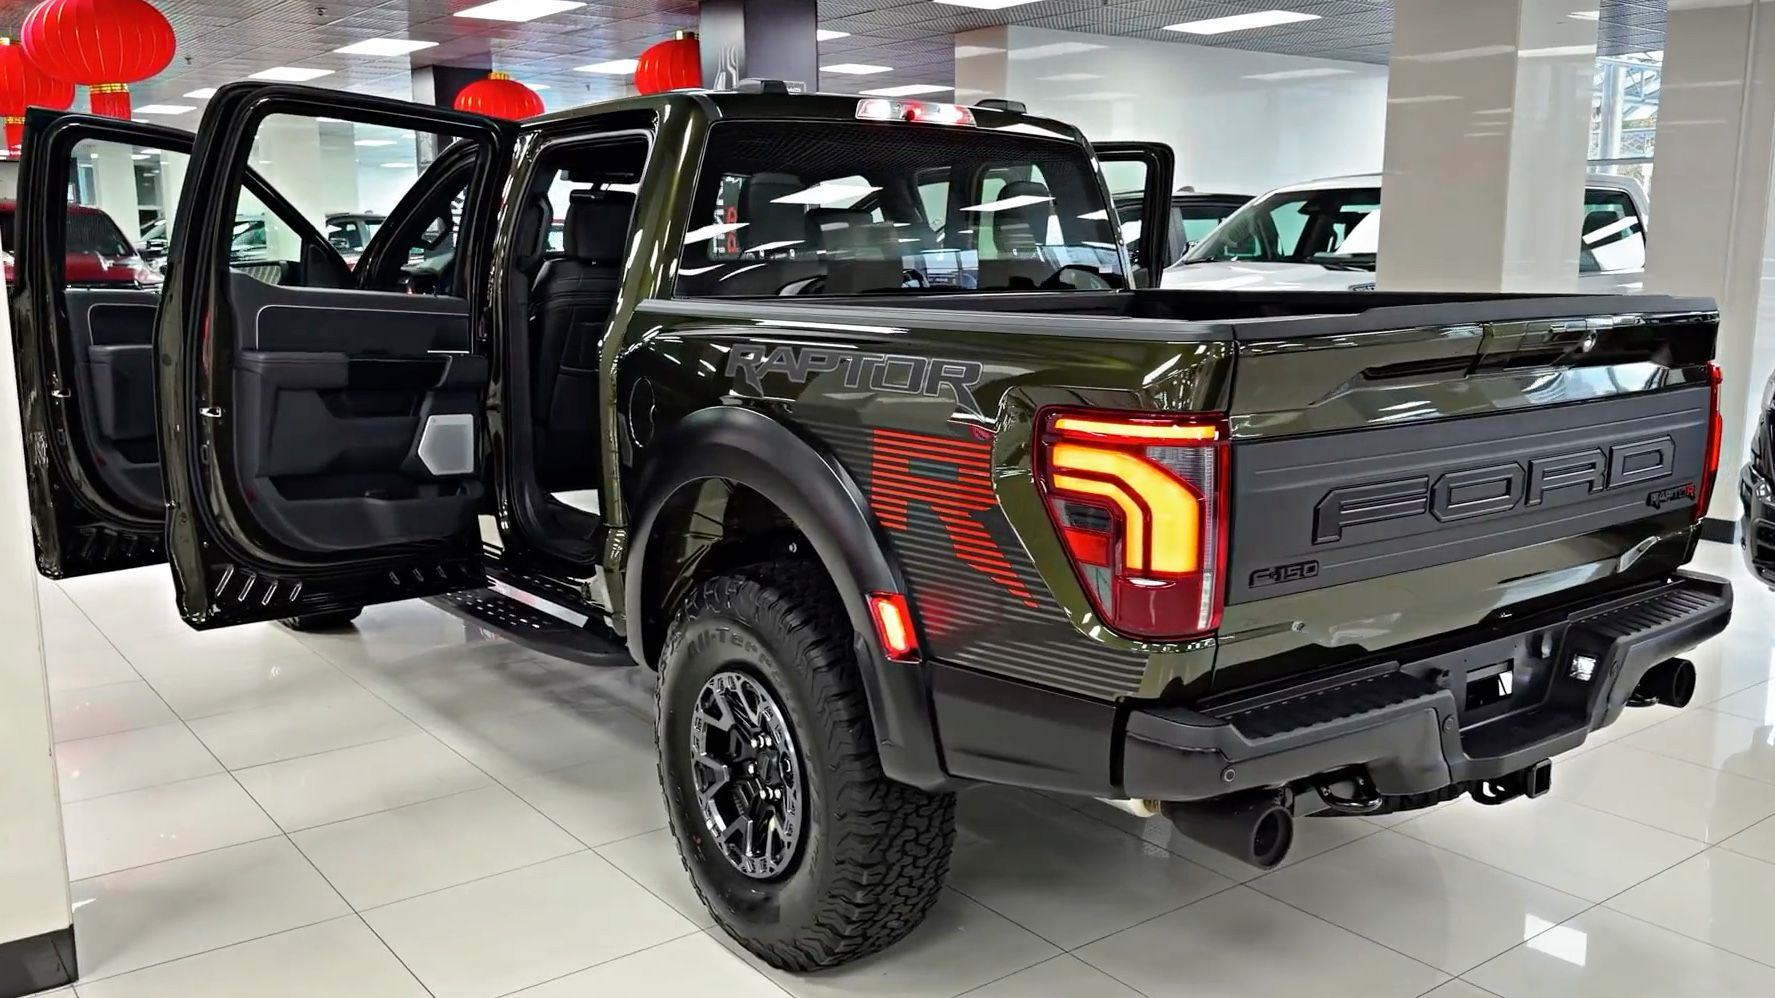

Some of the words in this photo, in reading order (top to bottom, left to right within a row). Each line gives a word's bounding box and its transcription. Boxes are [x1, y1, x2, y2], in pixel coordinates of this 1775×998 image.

[725, 343, 986, 422] RAPTOR
[1312, 434, 1677, 545] FORD
[1248, 560, 1319, 588] F-150
